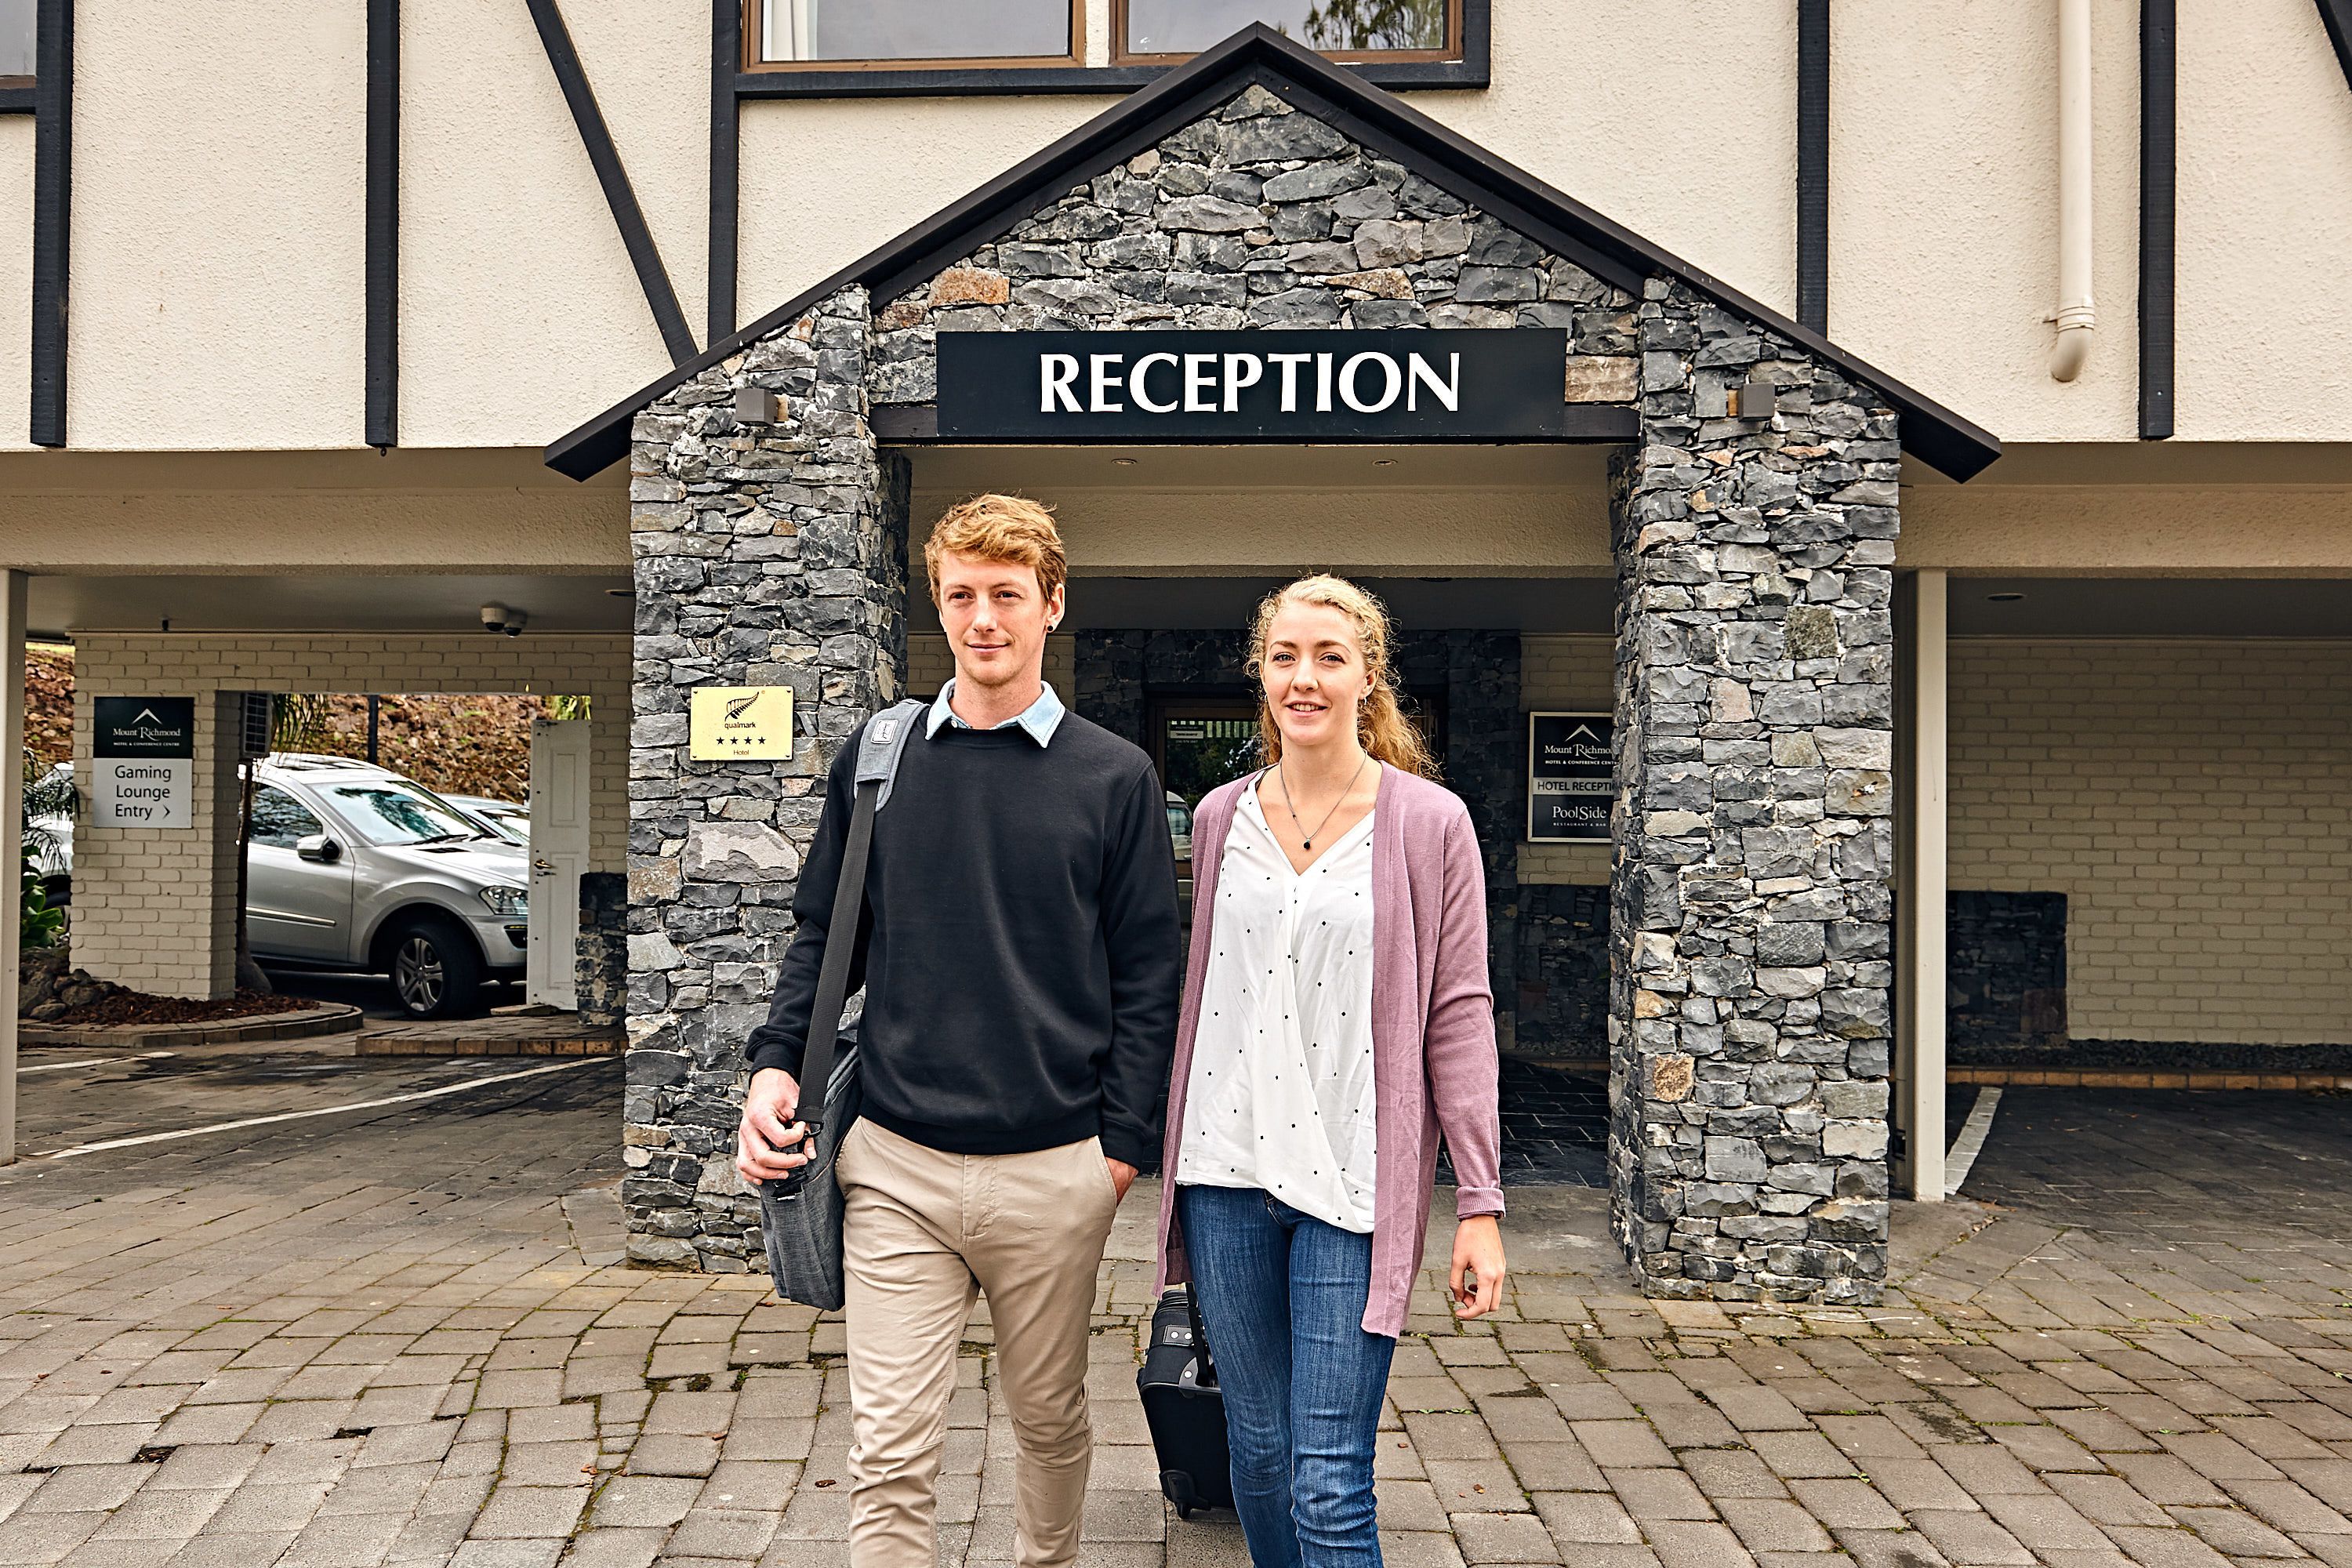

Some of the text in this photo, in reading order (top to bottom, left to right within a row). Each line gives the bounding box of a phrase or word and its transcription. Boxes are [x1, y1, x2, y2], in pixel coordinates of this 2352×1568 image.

[1040, 351, 1460, 413] RECEPTION
[113, 727, 181, 741] Mount Richmond
[1544, 743, 1612, 759] Mount Richmo
[114, 765, 172, 782] Gaming
[116, 785, 170, 801] Lounge
[1537, 782, 1614, 791] HOTEL RECEPTI
[115, 804, 153, 821] Entry
[1552, 806, 1606, 820] PoolSide
